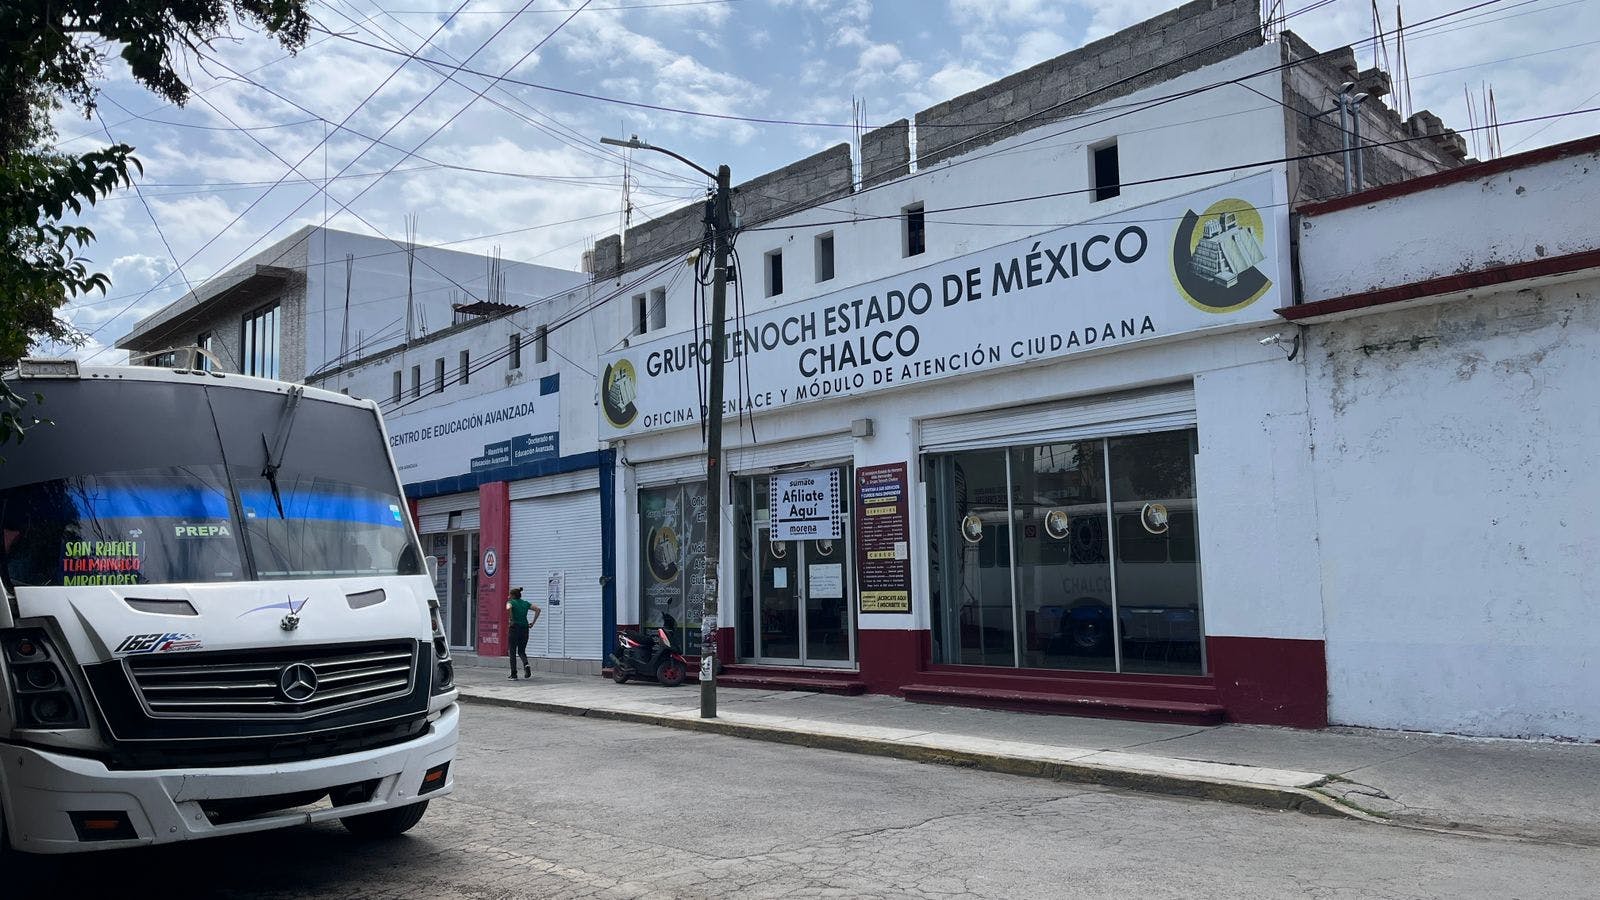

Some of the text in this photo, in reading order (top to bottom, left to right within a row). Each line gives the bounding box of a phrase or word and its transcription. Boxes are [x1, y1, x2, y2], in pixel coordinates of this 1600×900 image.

[646, 338, 713, 378] GRUPO
[824, 282, 932, 337] ESTADO
[942, 267, 982, 307] DE
[992, 225, 1148, 297] MÉXICO
[799, 325, 920, 378] CHALCO
[643, 407, 694, 428] OFICINA
[780, 389, 788, 403] Y
[796, 373, 865, 399] MÓDULO
[873, 368, 893, 385] DE
[901, 343, 1000, 380] ATENCIÓN
[1010, 315, 1155, 358] CIUDADANA
[390, 401, 535, 447] CENTRO DE EDUCACIÓN AVANZADA
[782, 488, 824, 503] Afiliate
[790, 503, 817, 520] Aquí
[175, 526, 230, 537] PREPA
[65, 541, 139, 557] SAN RAFAEL
